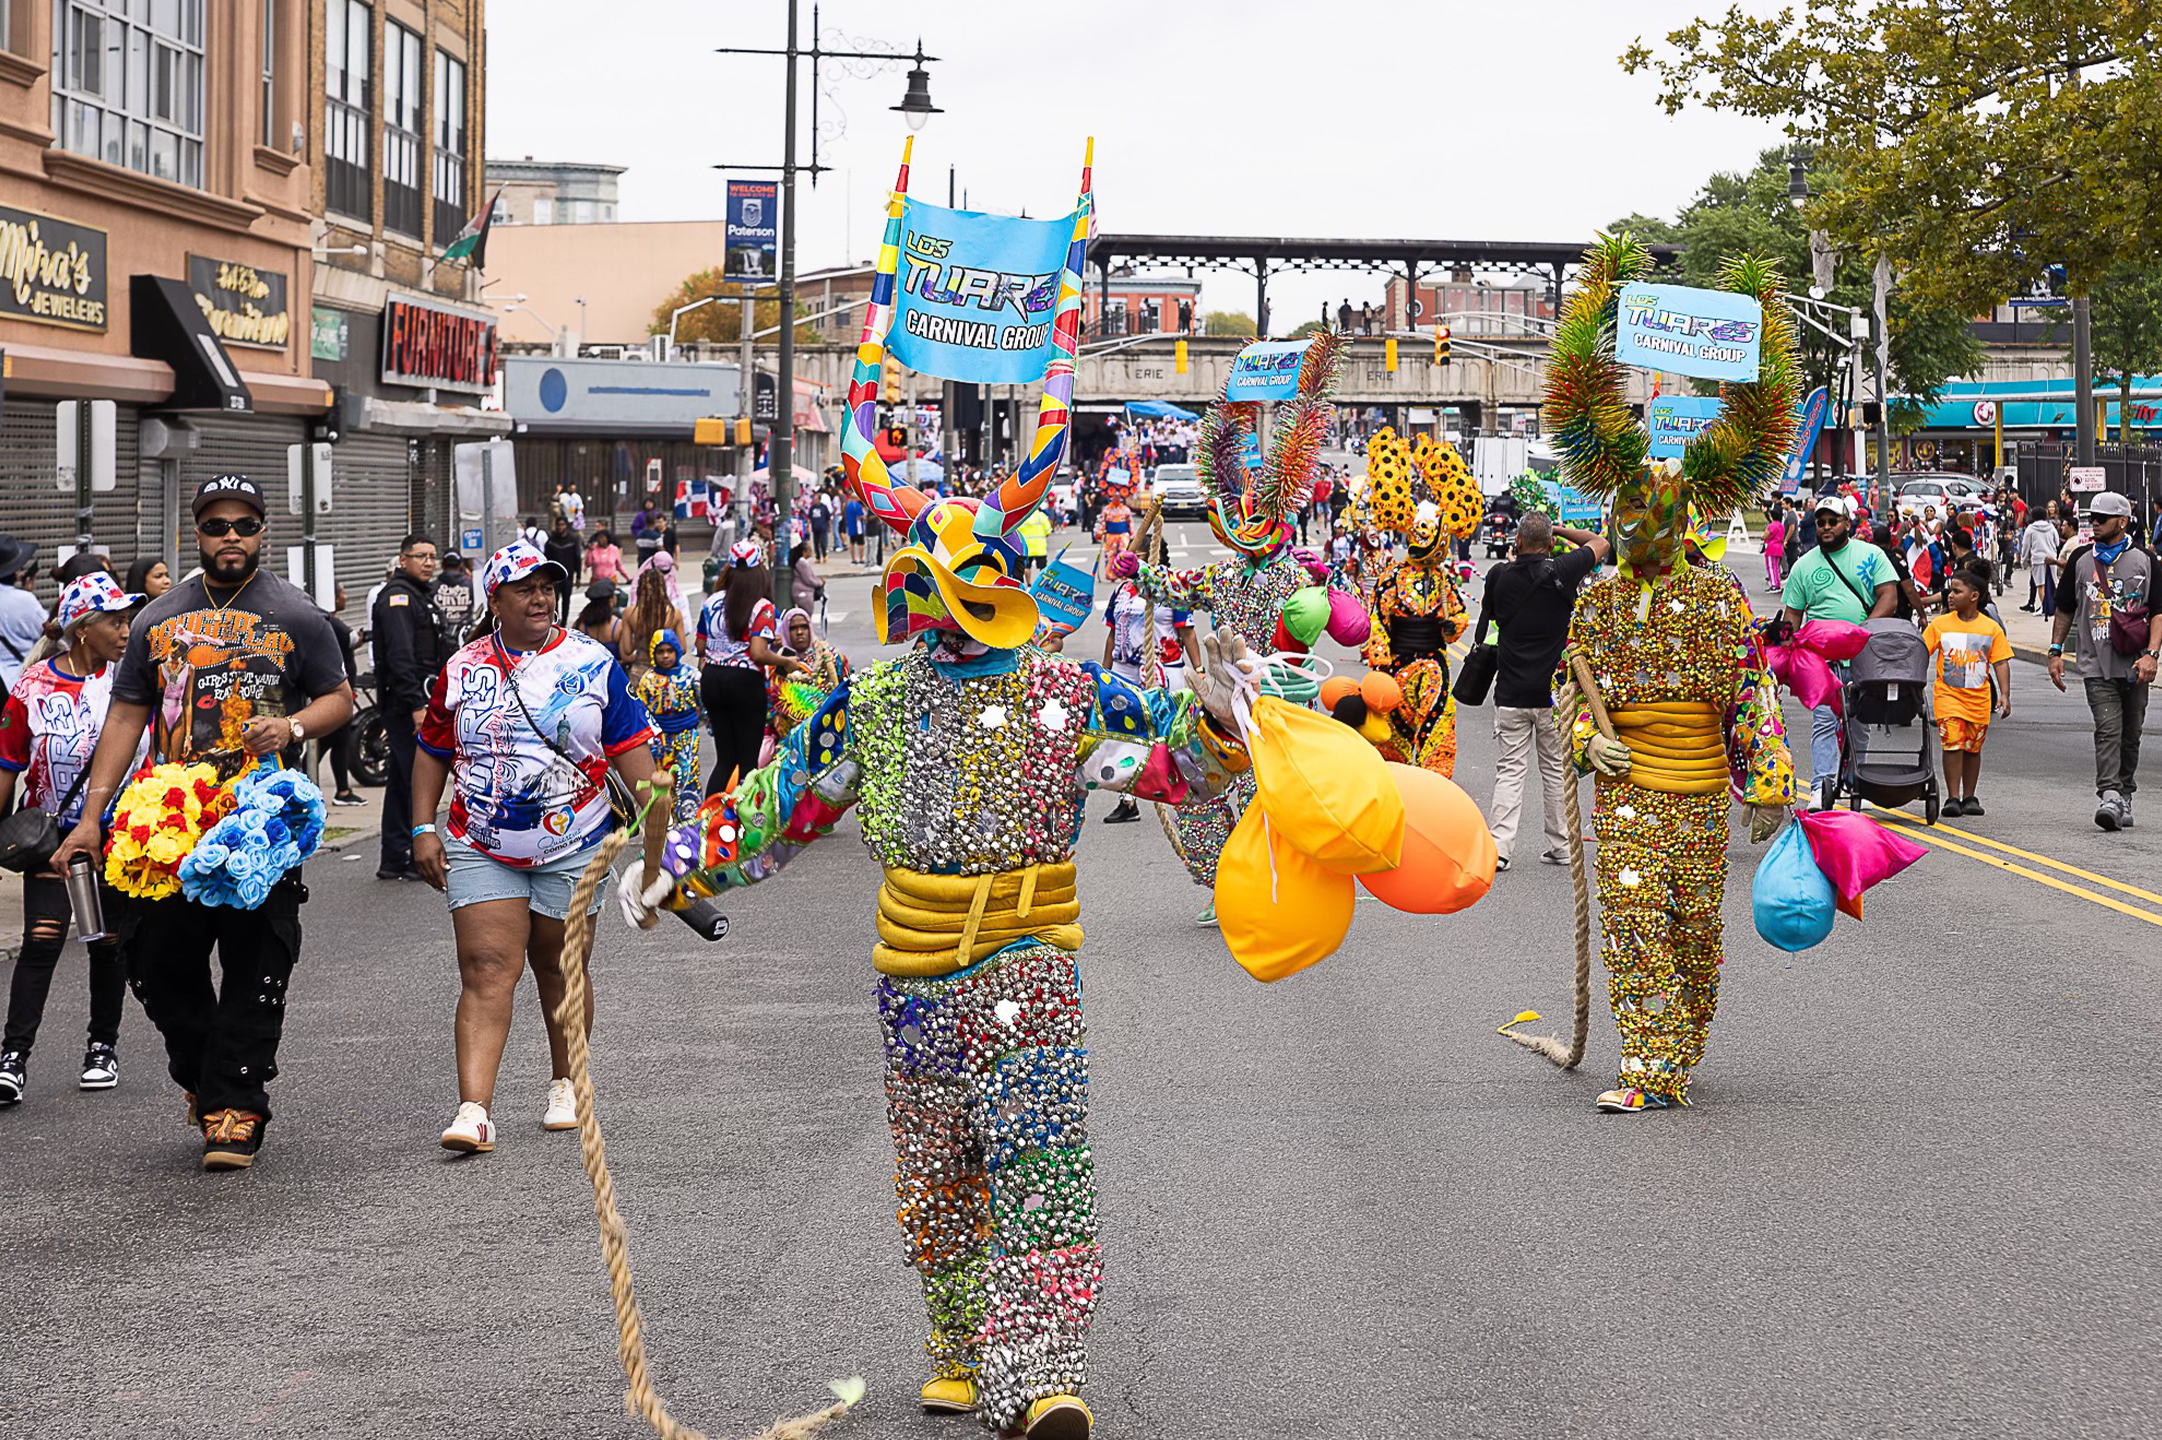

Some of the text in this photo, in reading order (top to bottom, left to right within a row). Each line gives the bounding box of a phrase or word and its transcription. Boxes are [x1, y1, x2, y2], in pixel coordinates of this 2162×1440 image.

[729, 185, 775, 193] WELCOME
[727, 224, 775, 237] Paterson
[907, 229, 953, 258] LOS
[29, 291, 105, 324] JEWELERS
[1626, 294, 1659, 306] LOS
[906, 308, 1050, 351] CARNIVAL GROUP
[1625, 304, 1758, 346] TUARES
[389, 302, 487, 386] FURNITURE
[1634, 333, 1747, 363] CARNIVAL GROUP
[1135, 369, 1163, 380] ERIE
[1236, 374, 1292, 387] CARNIVAL GROUP
[1367, 371, 1394, 381] ERIE
[1654, 406, 1673, 414] LOS
[1796, 392, 1825, 457] PROPANE
[219, 475, 239, 490] NY
[1035, 591, 1086, 618] CARNIVAL GROUP
[544, 835, 583, 854] como soy
